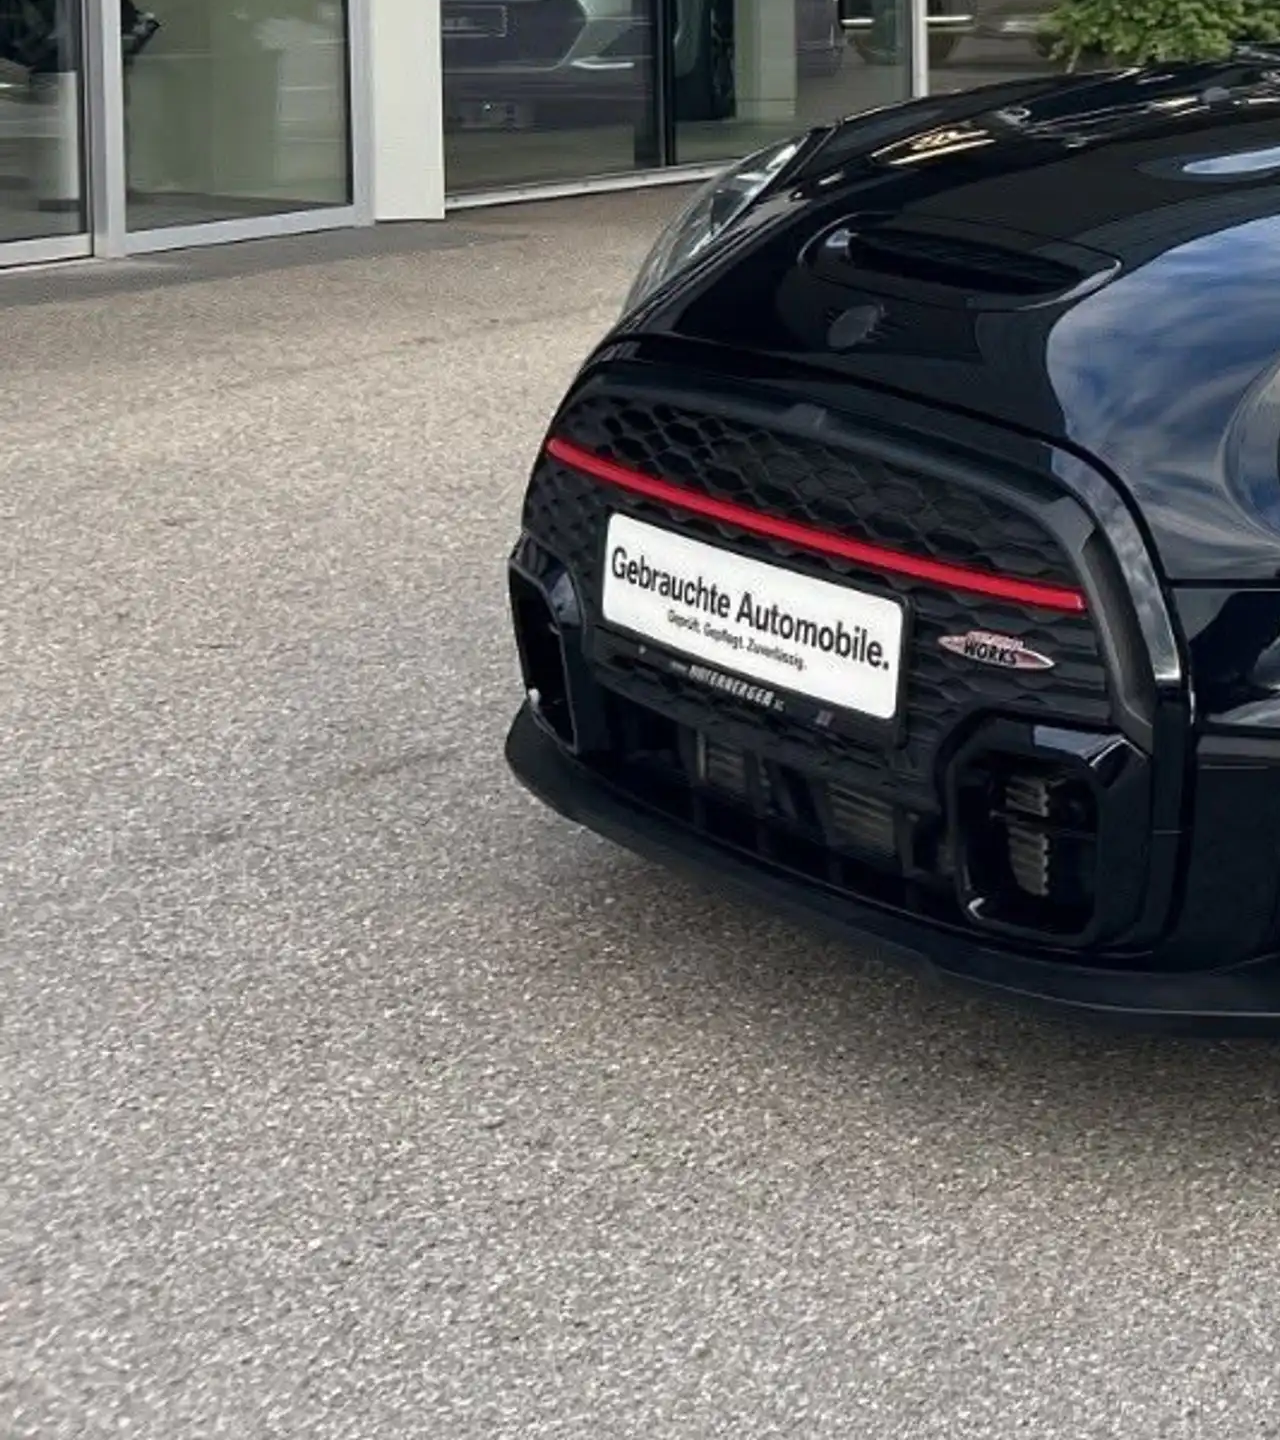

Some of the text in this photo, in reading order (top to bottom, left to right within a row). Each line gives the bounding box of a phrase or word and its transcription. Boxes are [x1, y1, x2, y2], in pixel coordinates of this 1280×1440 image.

[611, 545, 890, 671] Gebrauchte Automobile.
[964, 640, 1018, 666] WORKS
